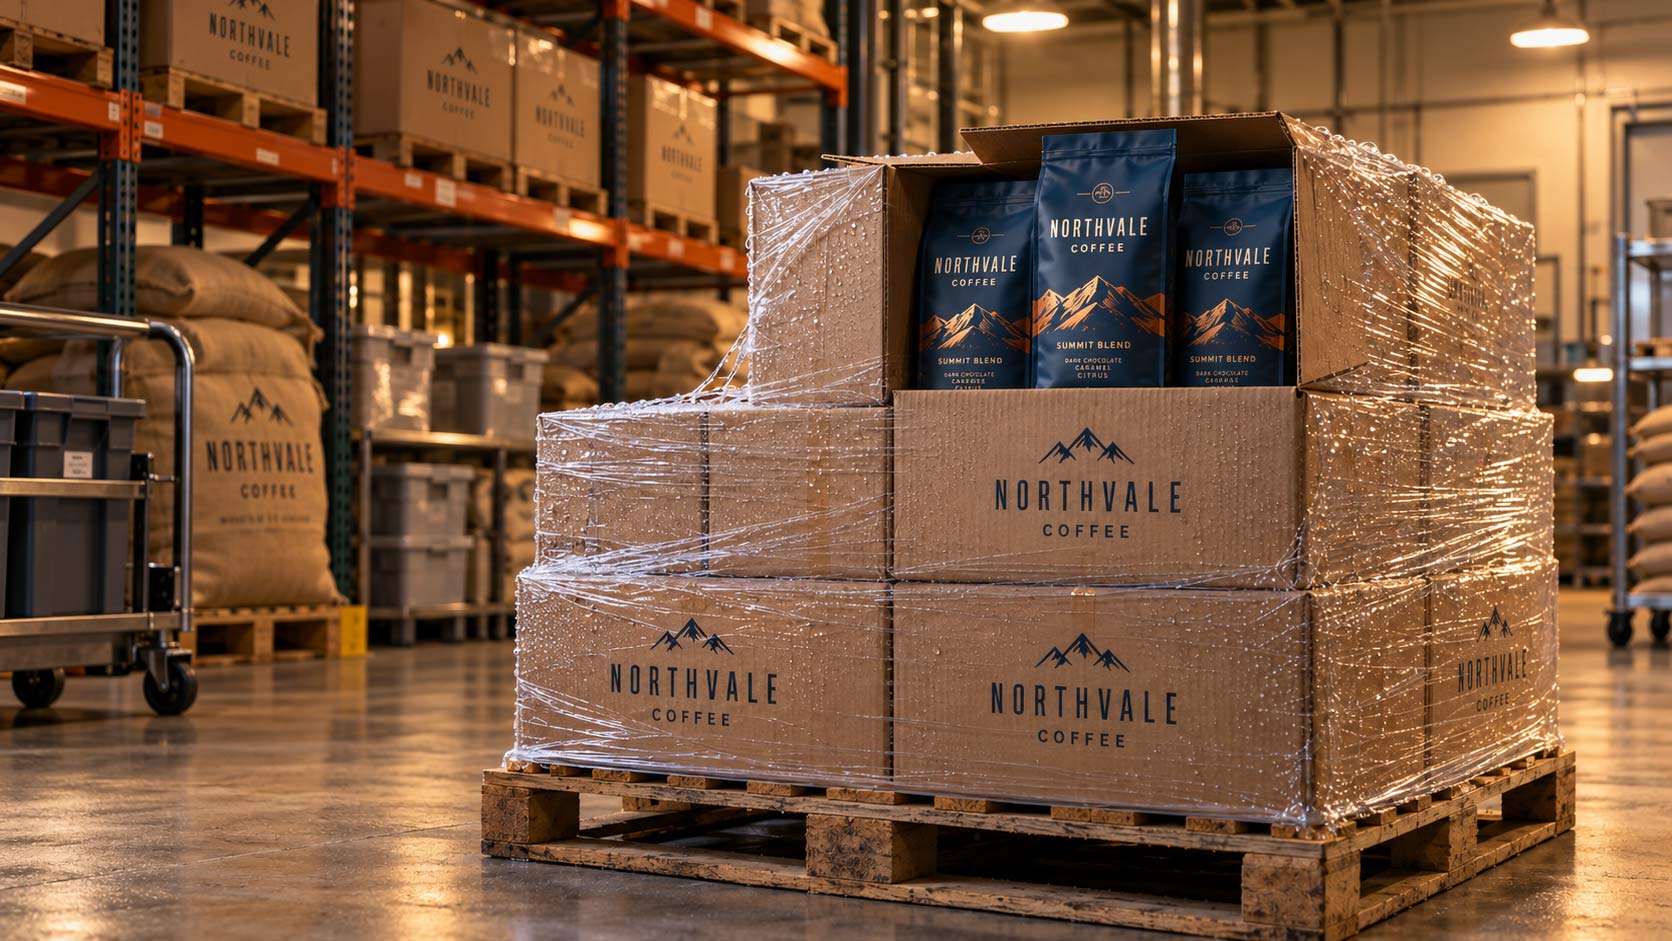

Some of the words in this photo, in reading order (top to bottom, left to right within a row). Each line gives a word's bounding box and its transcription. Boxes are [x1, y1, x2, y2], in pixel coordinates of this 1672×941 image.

[209, 12, 290, 59] NORTHVALE
[229, 49, 270, 71] COFFEE
[427, 69, 490, 108] NORTHVALE
[1050, 216, 1148, 238] NORTHVALE
[1070, 242, 1125, 253] COFFEE
[934, 255, 1017, 274] NORTHVALE
[1185, 247, 1271, 268] NORTHVALE
[951, 278, 996, 287] COFFEE
[1203, 271, 1249, 280] COFFEE
[1056, 341, 1094, 350] SUMMIT
[1097, 341, 1131, 350] BLEND
[937, 357, 971, 365] SUMMIT
[1189, 355, 1223, 363] SUMMIT
[1226, 355, 1256, 363] BLEND
[206, 440, 314, 473] NORTHVALE
[241, 483, 296, 499] COFFEE
[995, 479, 1181, 513] NORTHVALE
[1042, 524, 1130, 539] COFFEE
[1458, 649, 1527, 692] NORTHVALE
[611, 663, 777, 704] NORTHVALE
[991, 682, 1177, 725] NORTHVALE
[1476, 692, 1510, 712] COFFEE
[652, 708, 730, 726] COFFEE
[1038, 729, 1125, 748] COFFEE
